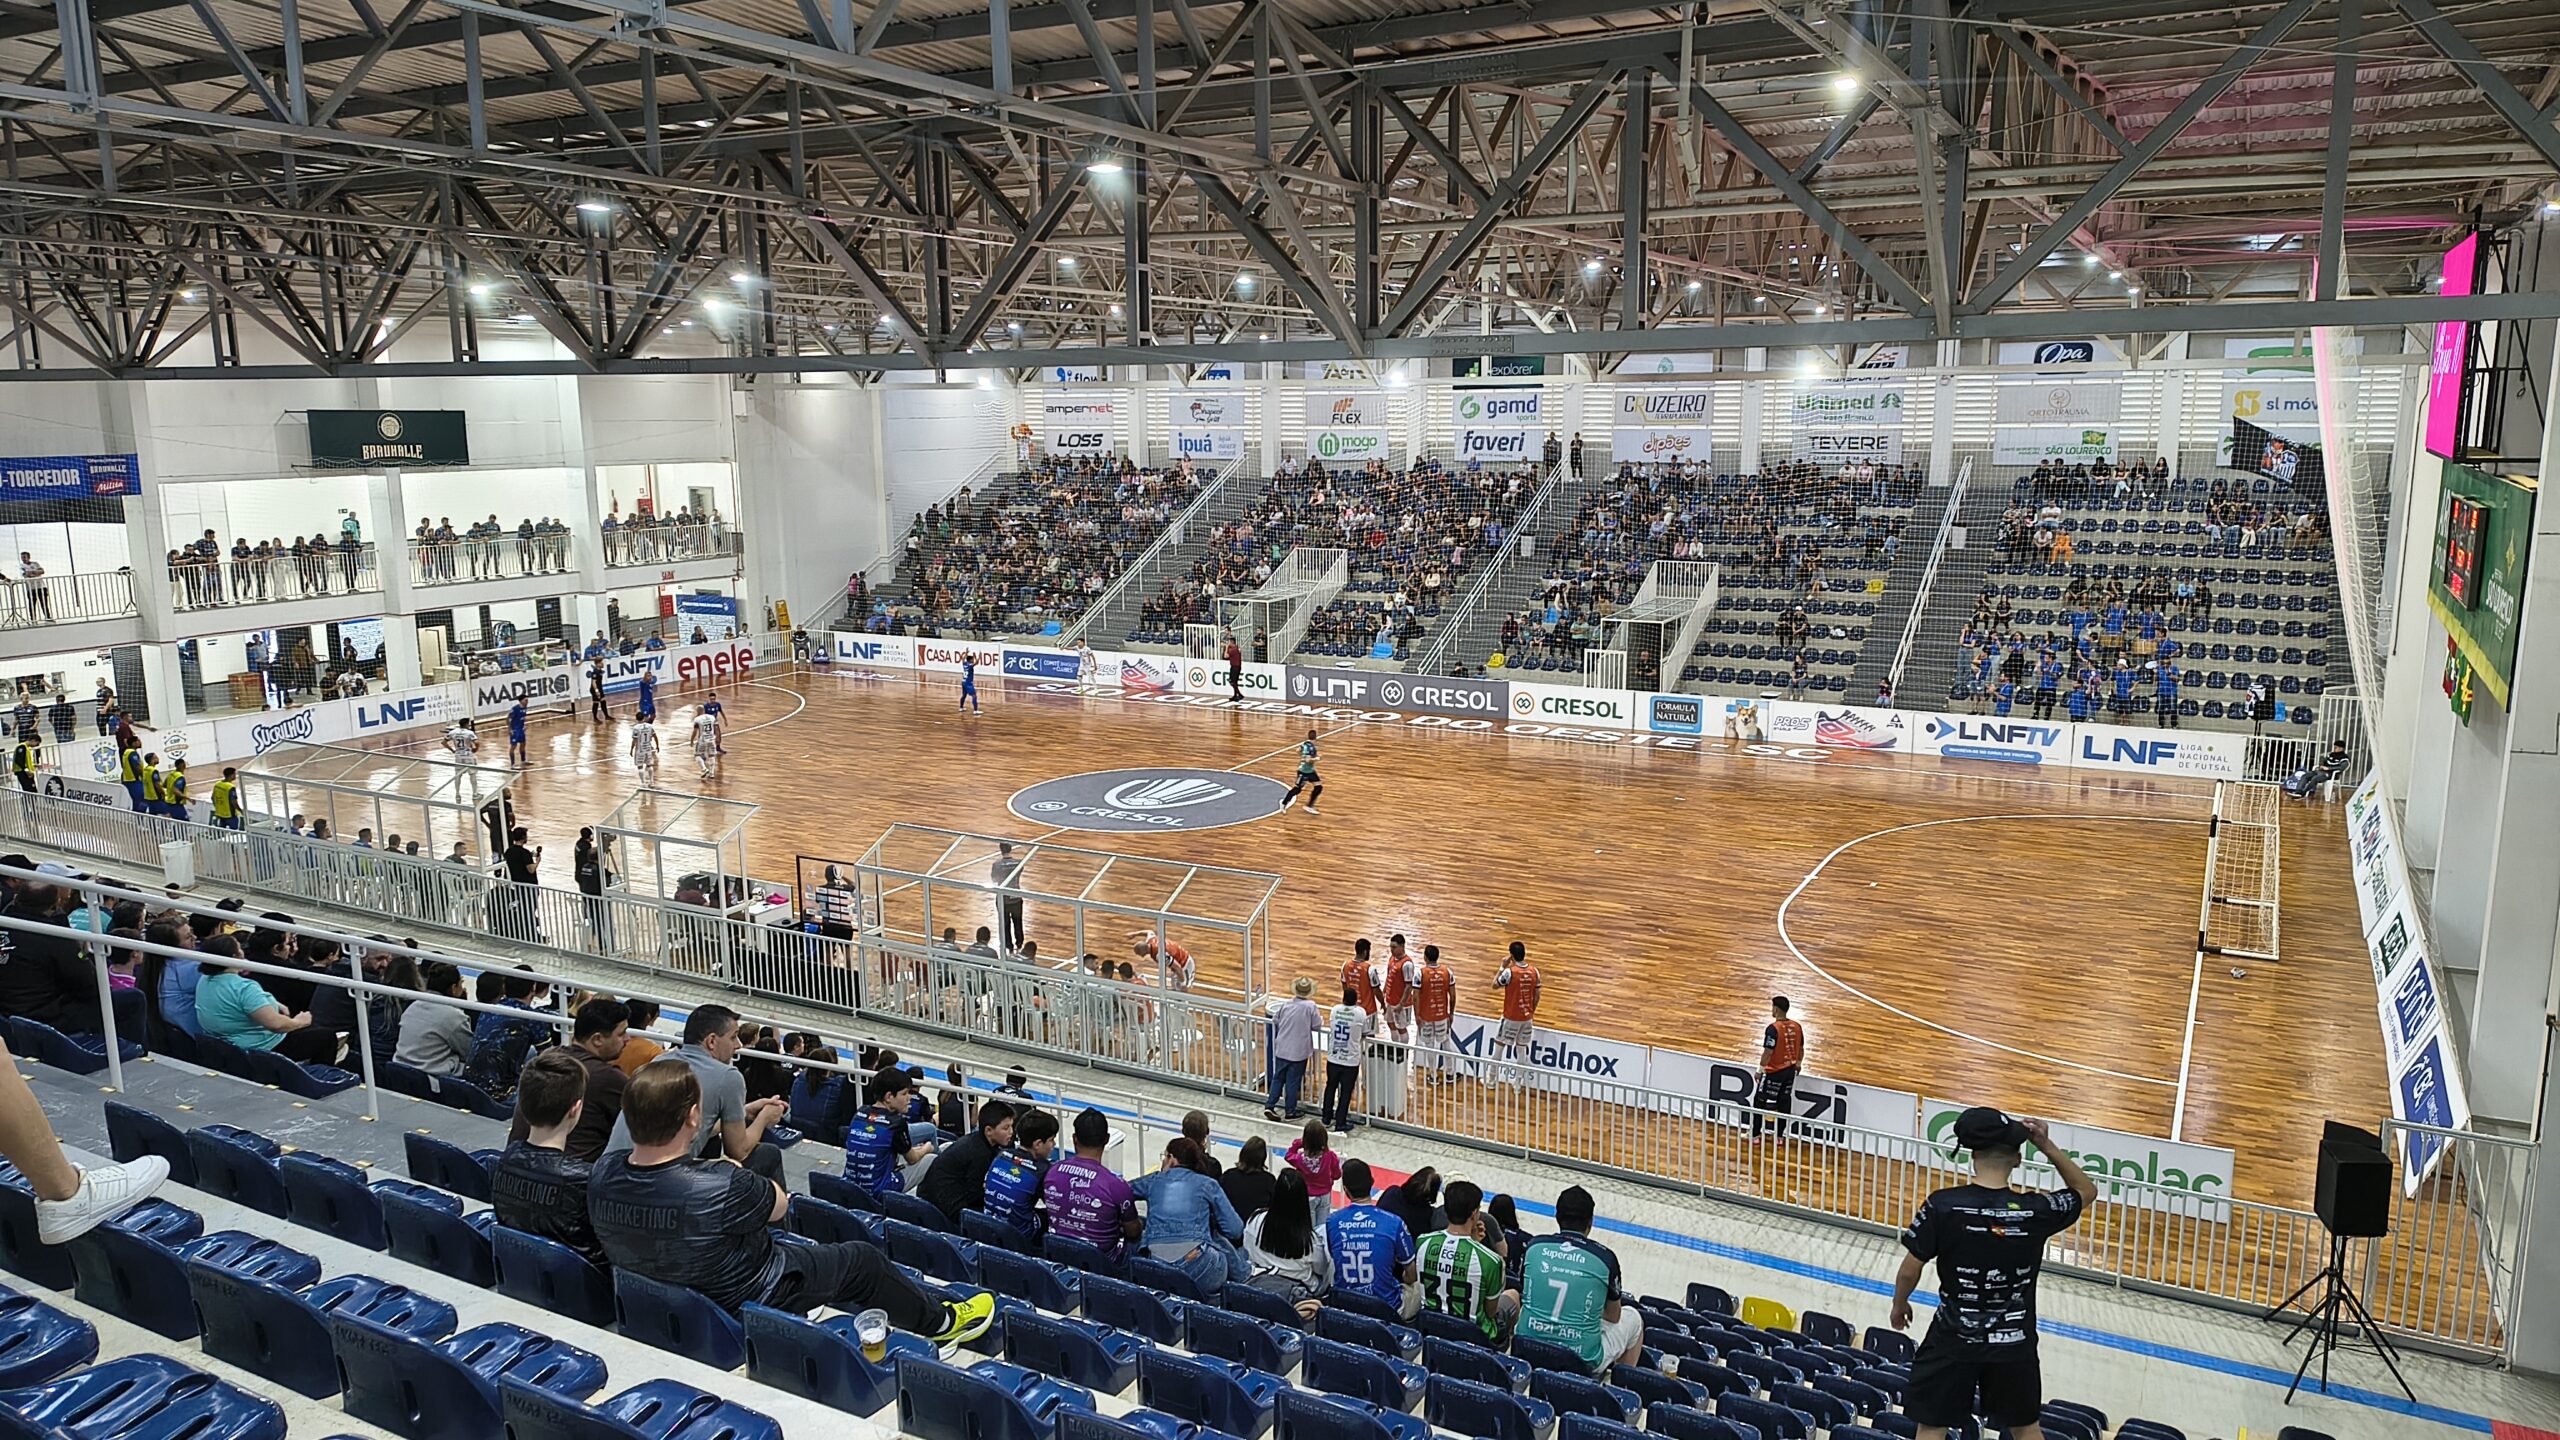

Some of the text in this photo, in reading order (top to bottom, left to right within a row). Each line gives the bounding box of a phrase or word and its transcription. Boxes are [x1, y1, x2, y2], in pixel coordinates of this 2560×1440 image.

[1046, 403, 1113, 415] ampernet
[1488, 394, 1537, 419] gamd
[1624, 395, 1706, 413] CRUZEIRO
[1797, 394, 1875, 410] Unimed
[1332, 413, 1361, 424] FLEX
[1057, 433, 1103, 447] LOSS
[1178, 432, 1212, 453] ipuá
[1342, 436, 1377, 452] mogo
[1464, 430, 1525, 454] faveri
[1808, 435, 1888, 450] TEVERE
[362, 445, 423, 460] BRAUHALLE
[0, 468, 81, 488] -TORCEDOR
[839, 640, 882, 660] LNF
[926, 648, 951, 662] CASA
[677, 644, 754, 681] enele
[1412, 686, 1499, 712] CRESOL
[1541, 697, 1623, 720] CRESOL
[1656, 701, 1696, 714] FÓRMULA
[358, 697, 426, 728] LNF
[1656, 711, 1696, 723] NATURAL
[1407, 715, 1494, 730] DO
[1504, 723, 1702, 748] OESTE
[1741, 744, 1834, 759] SC
[1959, 721, 2061, 747] LNFTV
[2083, 735, 2178, 766] LNF
[2179, 752, 2229, 763] NACIONAL
[1070, 805, 1184, 827] CRESOL
[1708, 1064, 1848, 1144] Rzi
[1058, 1163, 1097, 1180] VITORINO
[492, 1170, 559, 1205] MARKETING
[599, 1201, 679, 1230] MARKETING
[1338, 1219, 1376, 1230] Superalfa
[1542, 1247, 1586, 1264] Superalfa
[1341, 1250, 1375, 1284] 26
[1548, 1277, 1569, 1321] 7
